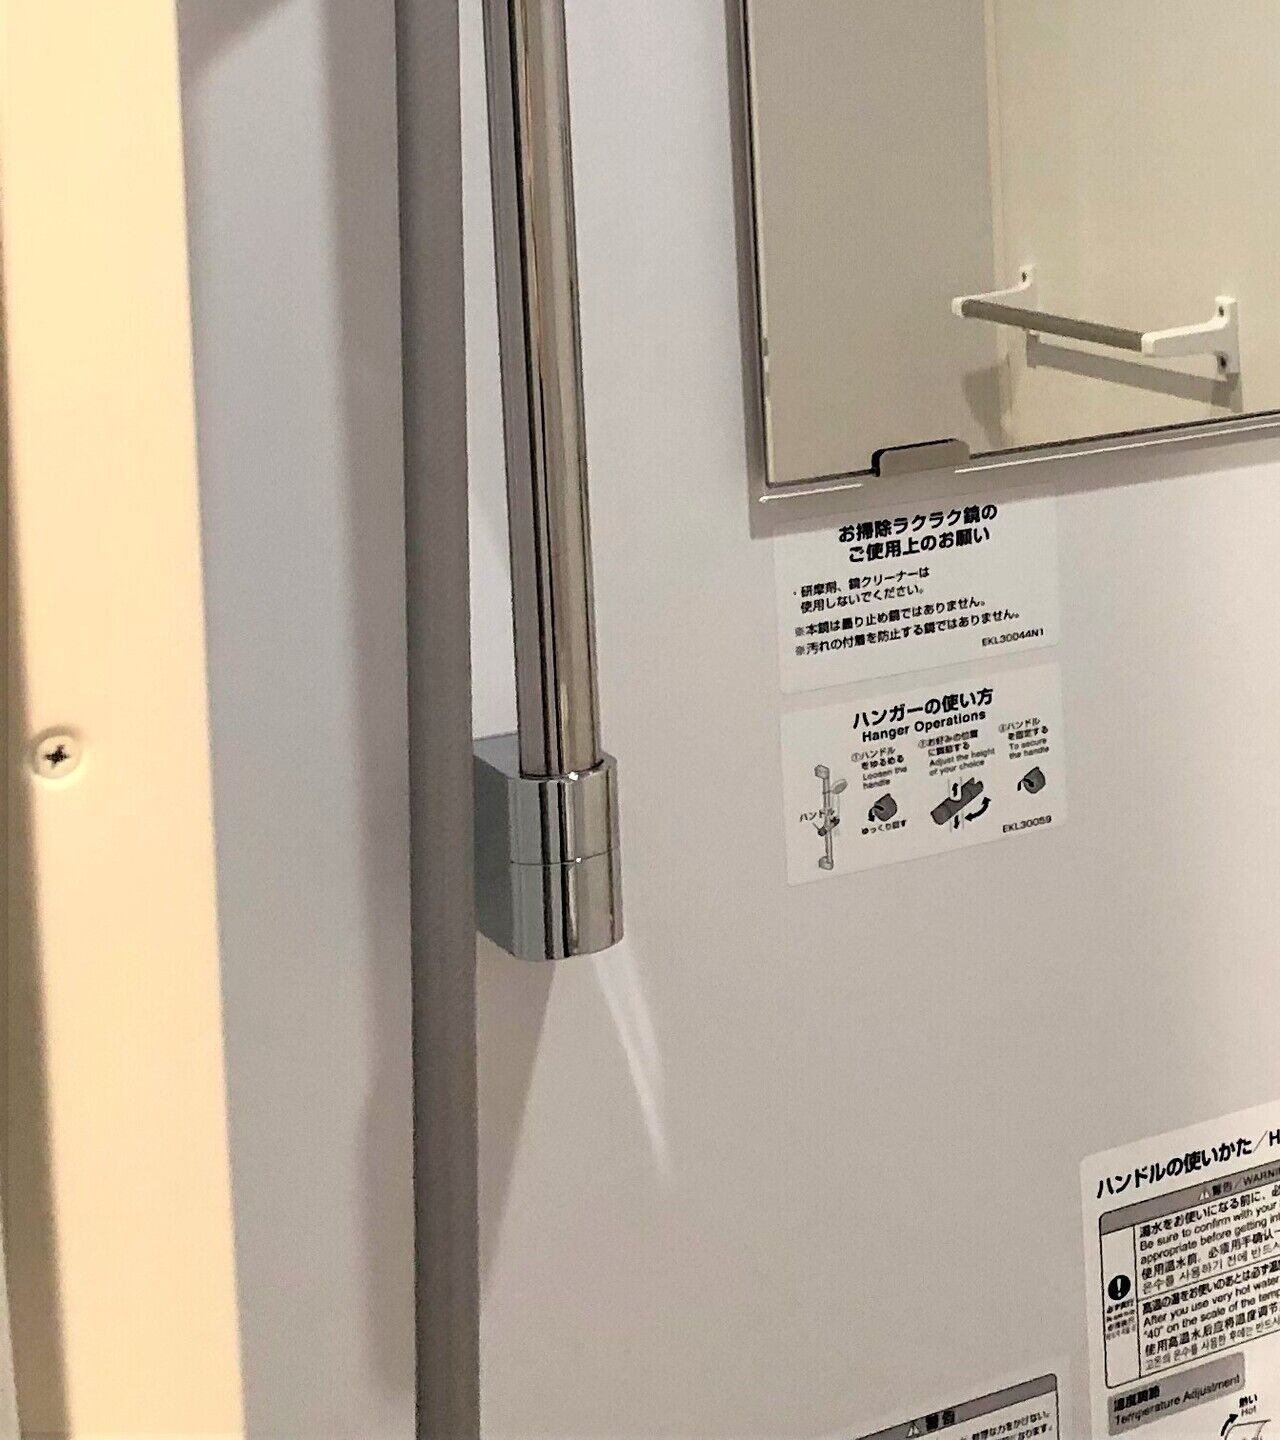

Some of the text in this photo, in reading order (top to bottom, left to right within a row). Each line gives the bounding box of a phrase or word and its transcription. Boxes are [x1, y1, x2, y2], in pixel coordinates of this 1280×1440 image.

[838, 504, 998, 543] お掃除ラクラク鏡の
[848, 526, 990, 564] ご使用上のお願い
[981, 628, 1044, 647] EKL30044N1
[853, 687, 994, 729] ハンガーの使い方
[862, 710, 987, 743] Hanger Operations
[929, 747, 996, 768] Adjust the height
[1009, 743, 1019, 751] To
[862, 766, 908, 782] Loosen the
[940, 766, 957, 776] your
[959, 759, 985, 770] choice
[1002, 815, 1052, 833] EKL30059
[1139, 1240, 1155, 1252] Be
[1156, 1232, 1180, 1247] sure
[1181, 1228, 1192, 1238] to
[1193, 1216, 1231, 1235] confirm
[1232, 1208, 1254, 1222] with
[1255, 1201, 1277, 1218] your
[1140, 1240, 1198, 1266] appropriate
[1200, 1229, 1232, 1246] before
[1234, 1217, 1268, 1237] getting
[1143, 1312, 1168, 1328] After
[1169, 1306, 1189, 1321] you
[1190, 1299, 1210, 1312] use
[1211, 1291, 1233, 1305] very
[1235, 1283, 1251, 1297] hot
[1166, 1322, 1180, 1334] on
[1181, 1316, 1198, 1329] the
[1200, 1307, 1226, 1323] scale
[1228, 1300, 1239, 1313] of
[1240, 1297, 1256, 1309] the
[1114, 1373, 1240, 1426] Temperature Adjustment
[1240, 1405, 1257, 1417] Hot
